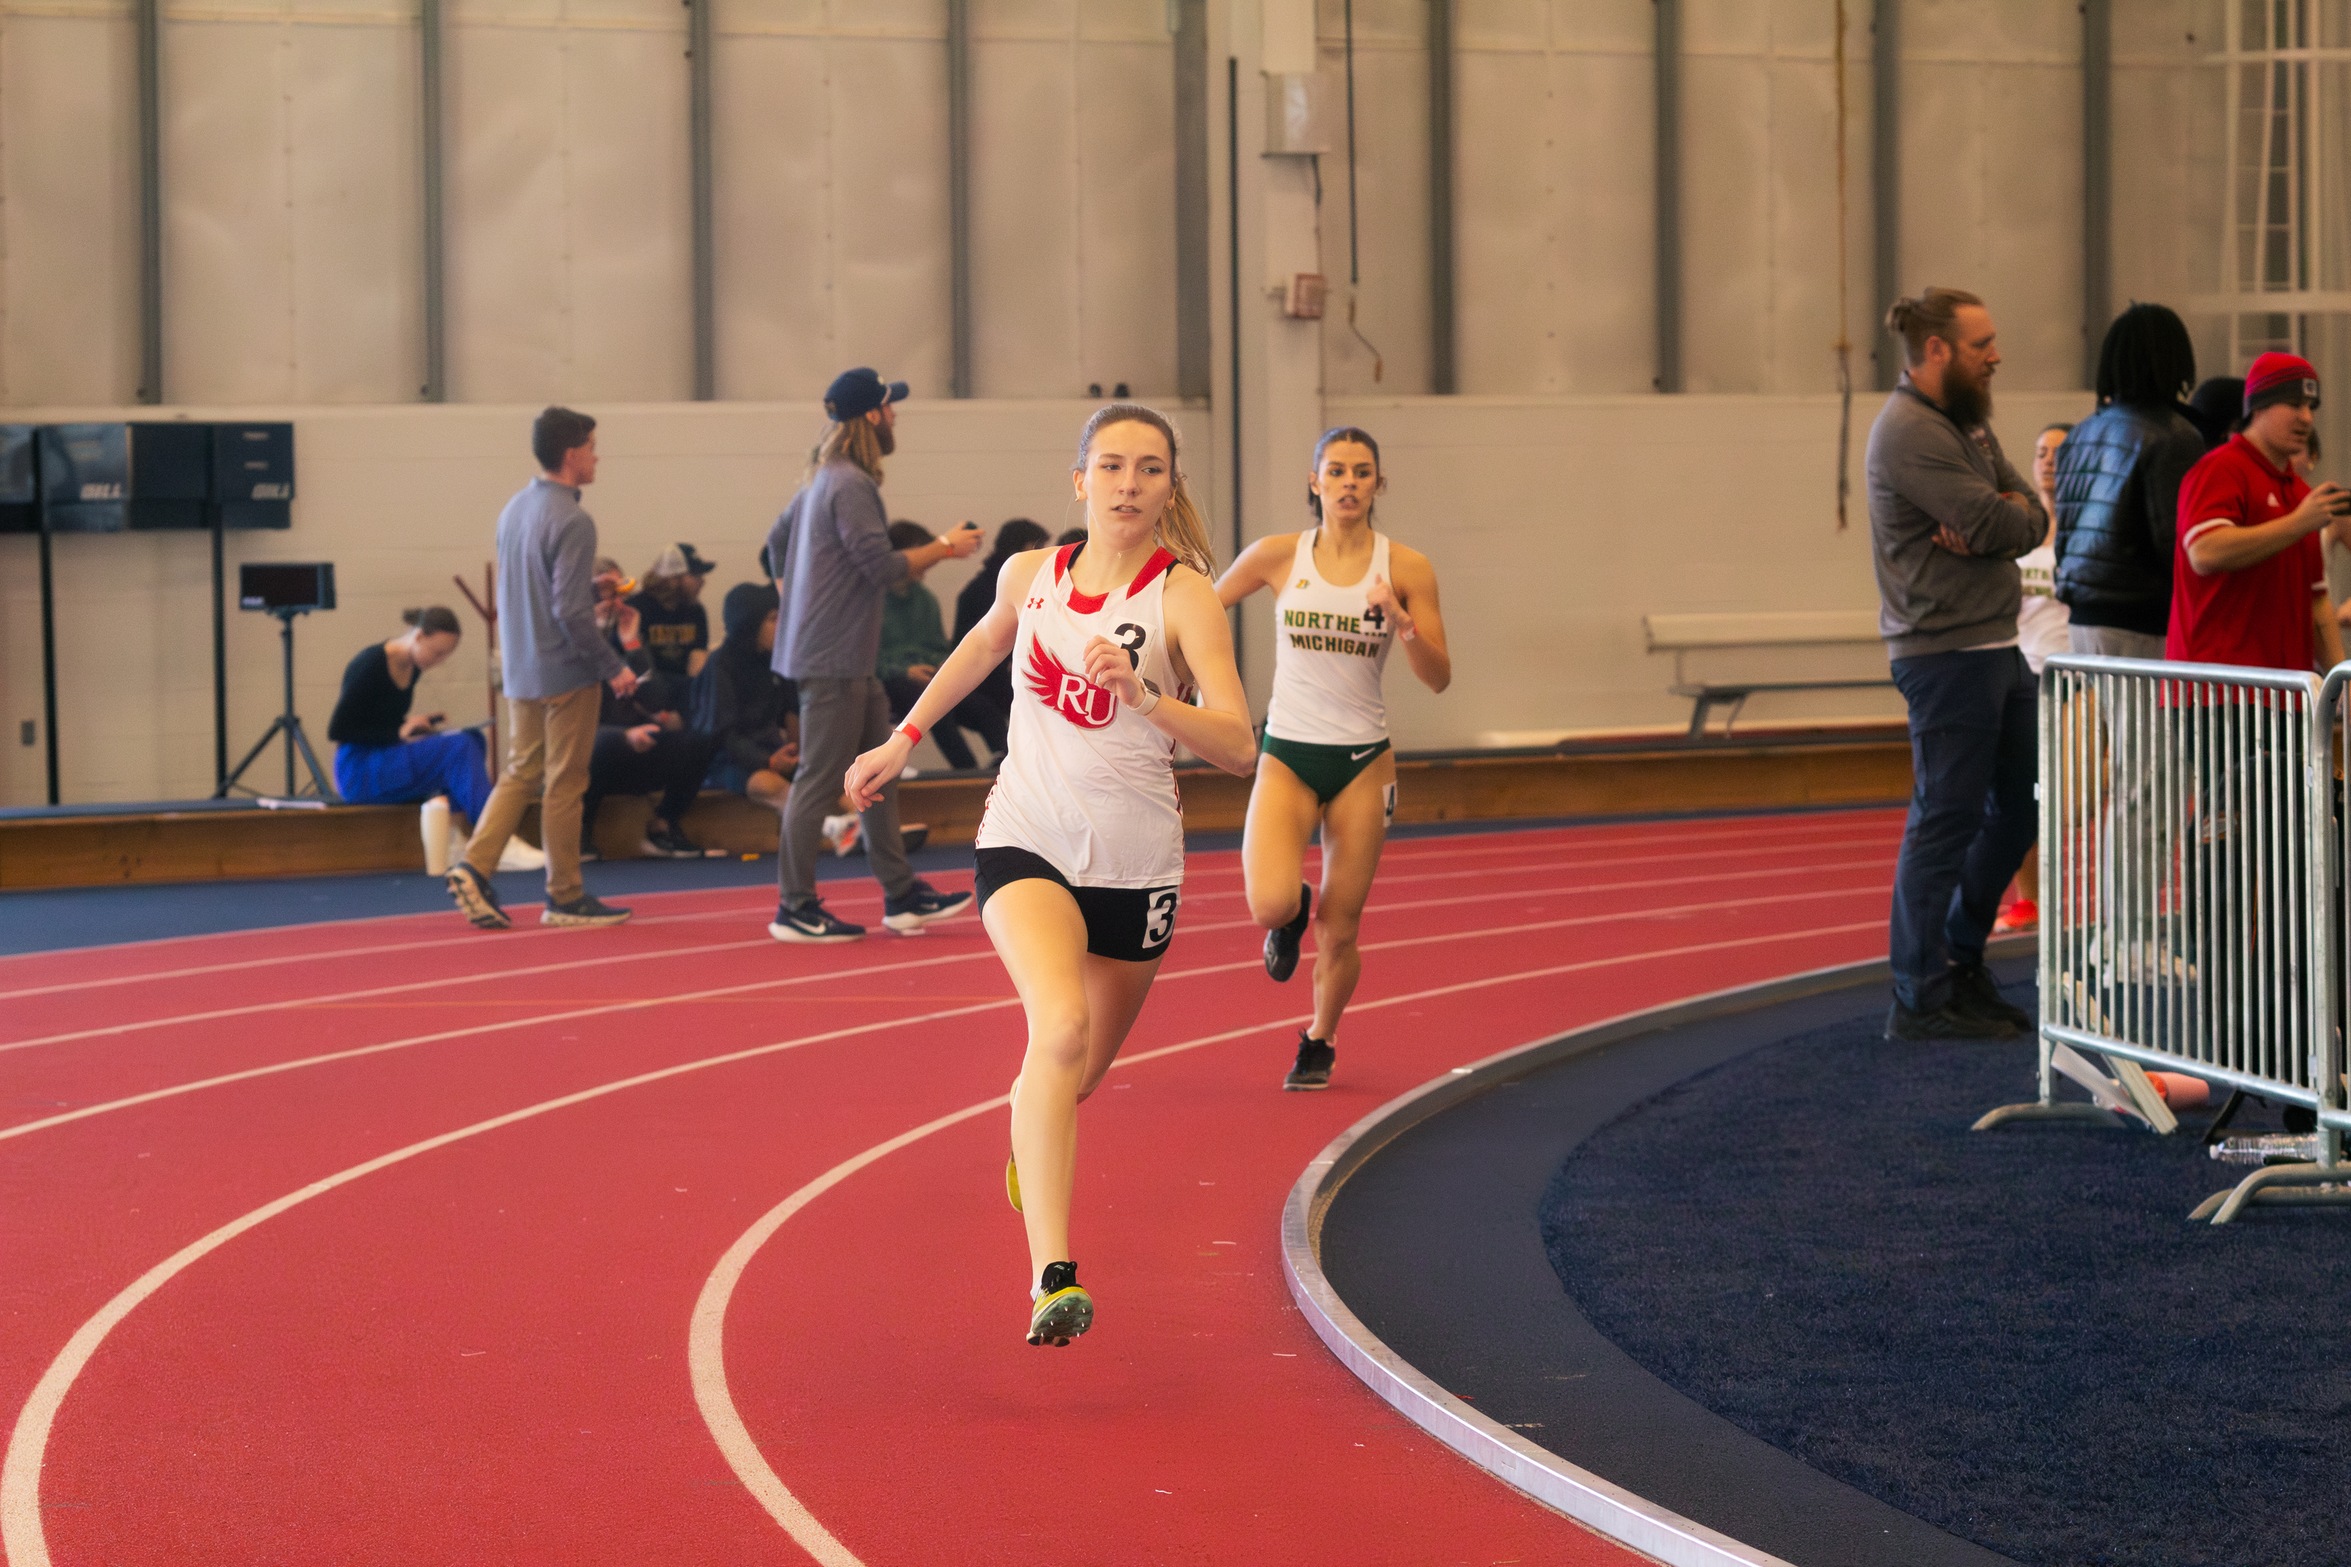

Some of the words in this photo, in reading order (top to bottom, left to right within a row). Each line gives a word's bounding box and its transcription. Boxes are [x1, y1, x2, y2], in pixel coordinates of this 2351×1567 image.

[1284, 609, 1388, 638] NORTHE
[1363, 603, 1386, 630] 4
[1114, 622, 1147, 672] 3
[1289, 633, 1380, 658] MICHIGAN
[1057, 673, 1117, 726] RU
[1149, 892, 1177, 943] 3
